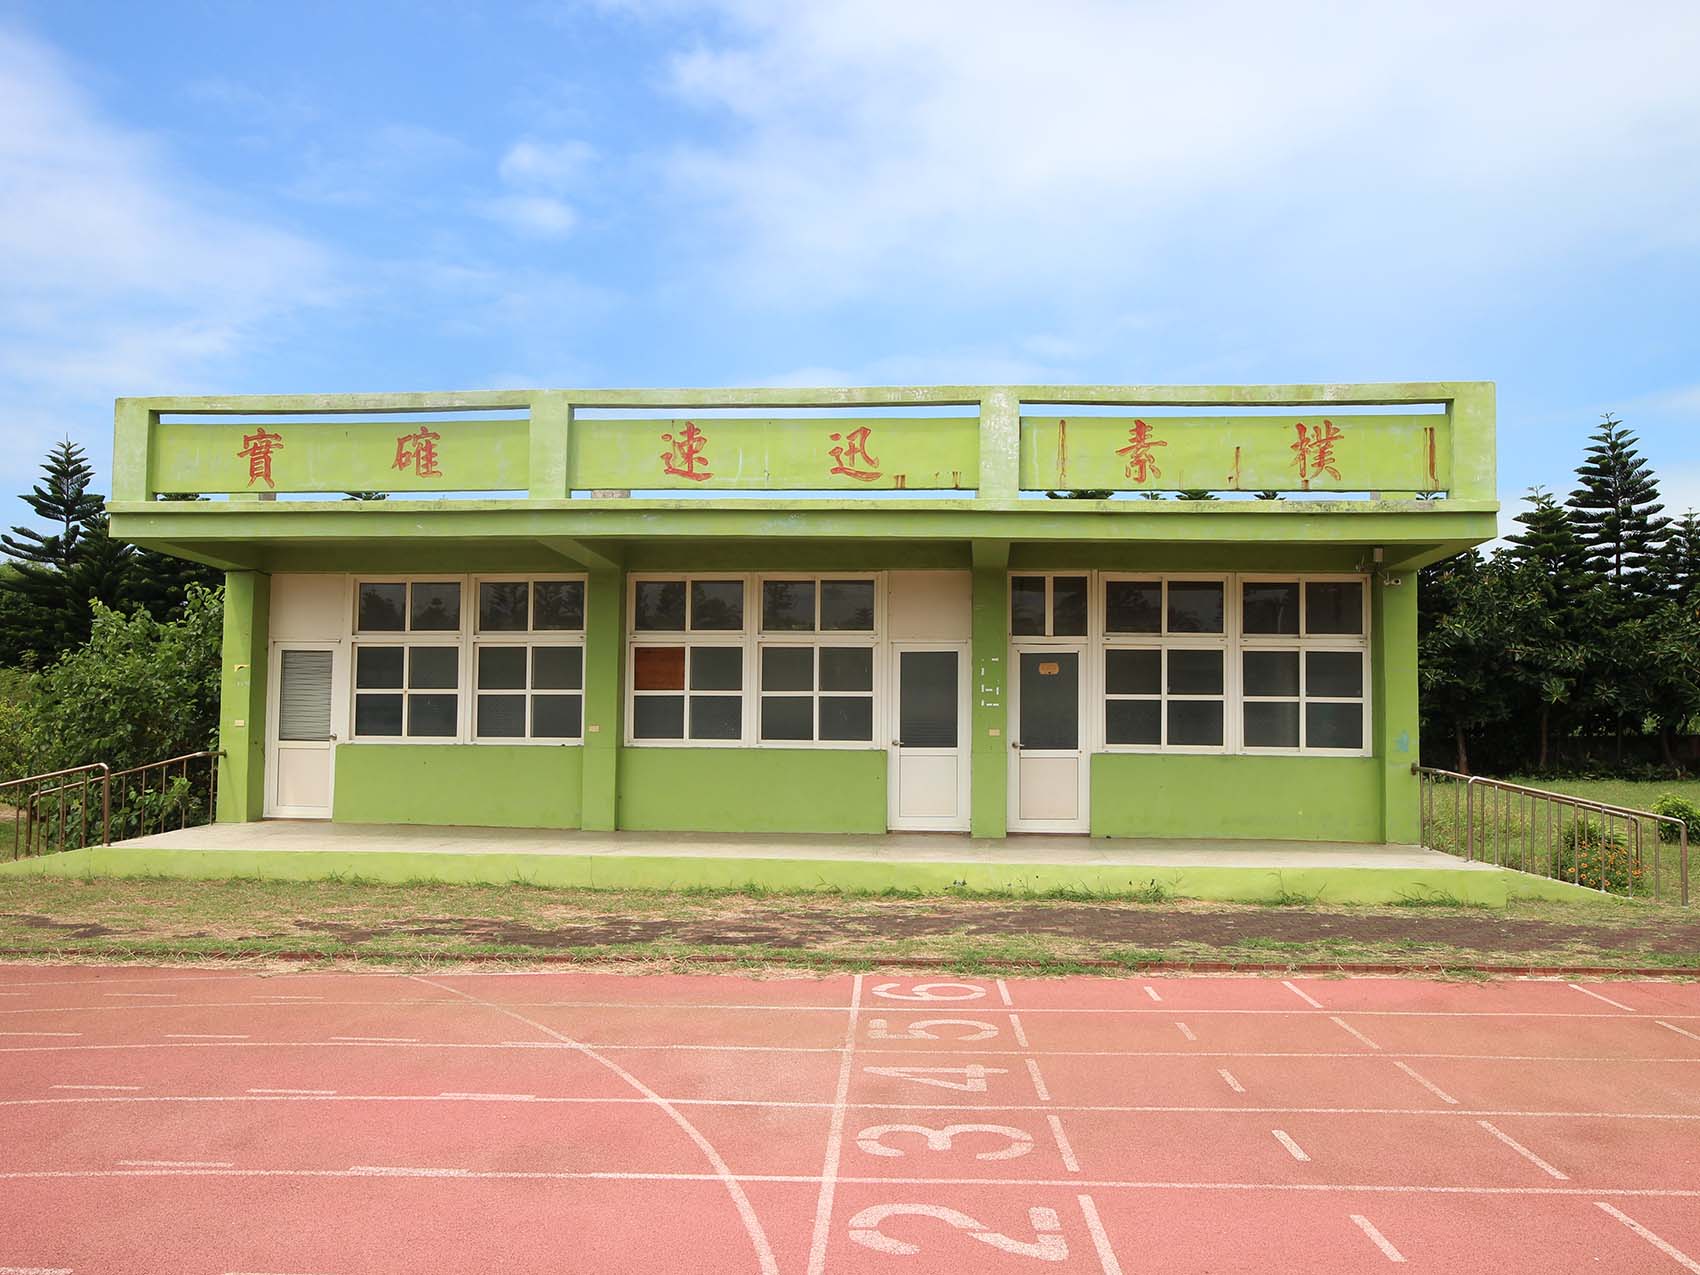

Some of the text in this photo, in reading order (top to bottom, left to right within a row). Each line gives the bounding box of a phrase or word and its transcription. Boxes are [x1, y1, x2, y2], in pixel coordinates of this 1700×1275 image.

[872, 982, 986, 1001] 6
[868, 1018, 999, 1040] 5
[863, 1064, 1008, 1092] 4
[856, 1123, 1034, 1161] 3
[848, 1203, 1069, 1262] 2
